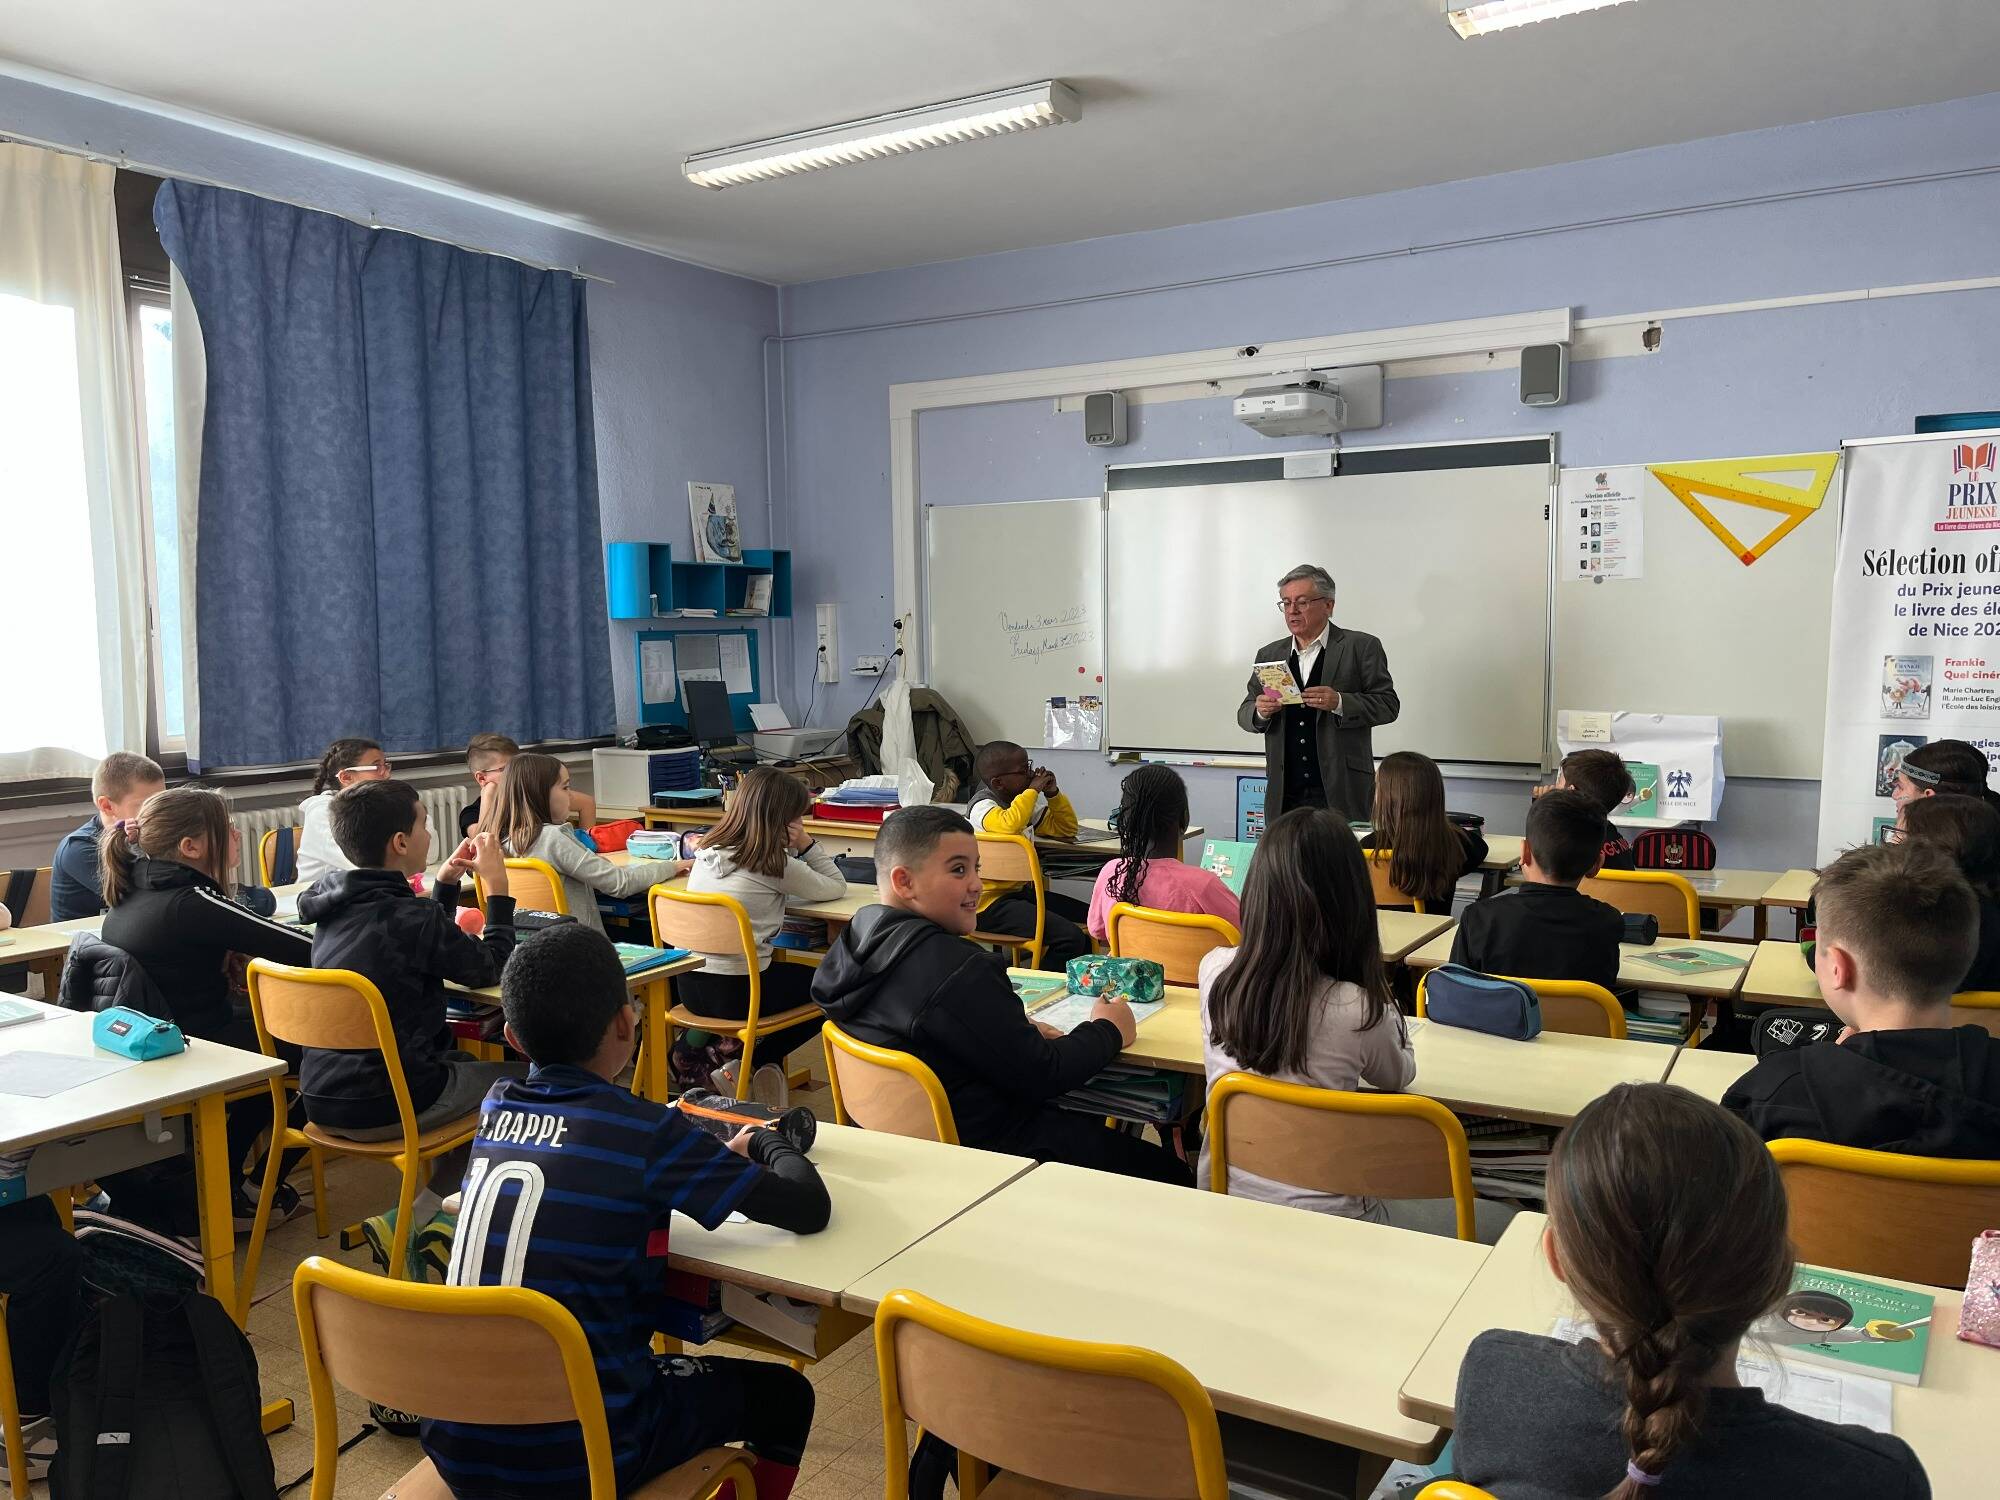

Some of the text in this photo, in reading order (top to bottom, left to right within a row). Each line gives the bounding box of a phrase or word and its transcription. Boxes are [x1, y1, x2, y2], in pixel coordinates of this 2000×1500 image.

[1968, 471, 1979, 482] LE
[1948, 482, 1997, 506] PRIX
[1946, 507, 1997, 520] JEUNESSE
[1862, 547, 1967, 577] Sélection
[1897, 584, 1916, 597] du
[1922, 583, 1953, 596] Prix
[1894, 603, 1906, 617] le
[1912, 603, 1945, 617] livre
[1950, 602, 1978, 616] des
[1908, 623, 1928, 637] de
[1933, 623, 1969, 637] Nice
[1945, 658, 1985, 667] Frankie
[1944, 670, 1970, 680] Quel
[1965, 703, 1978, 711] des
[446, 1157, 545, 1287] 10
